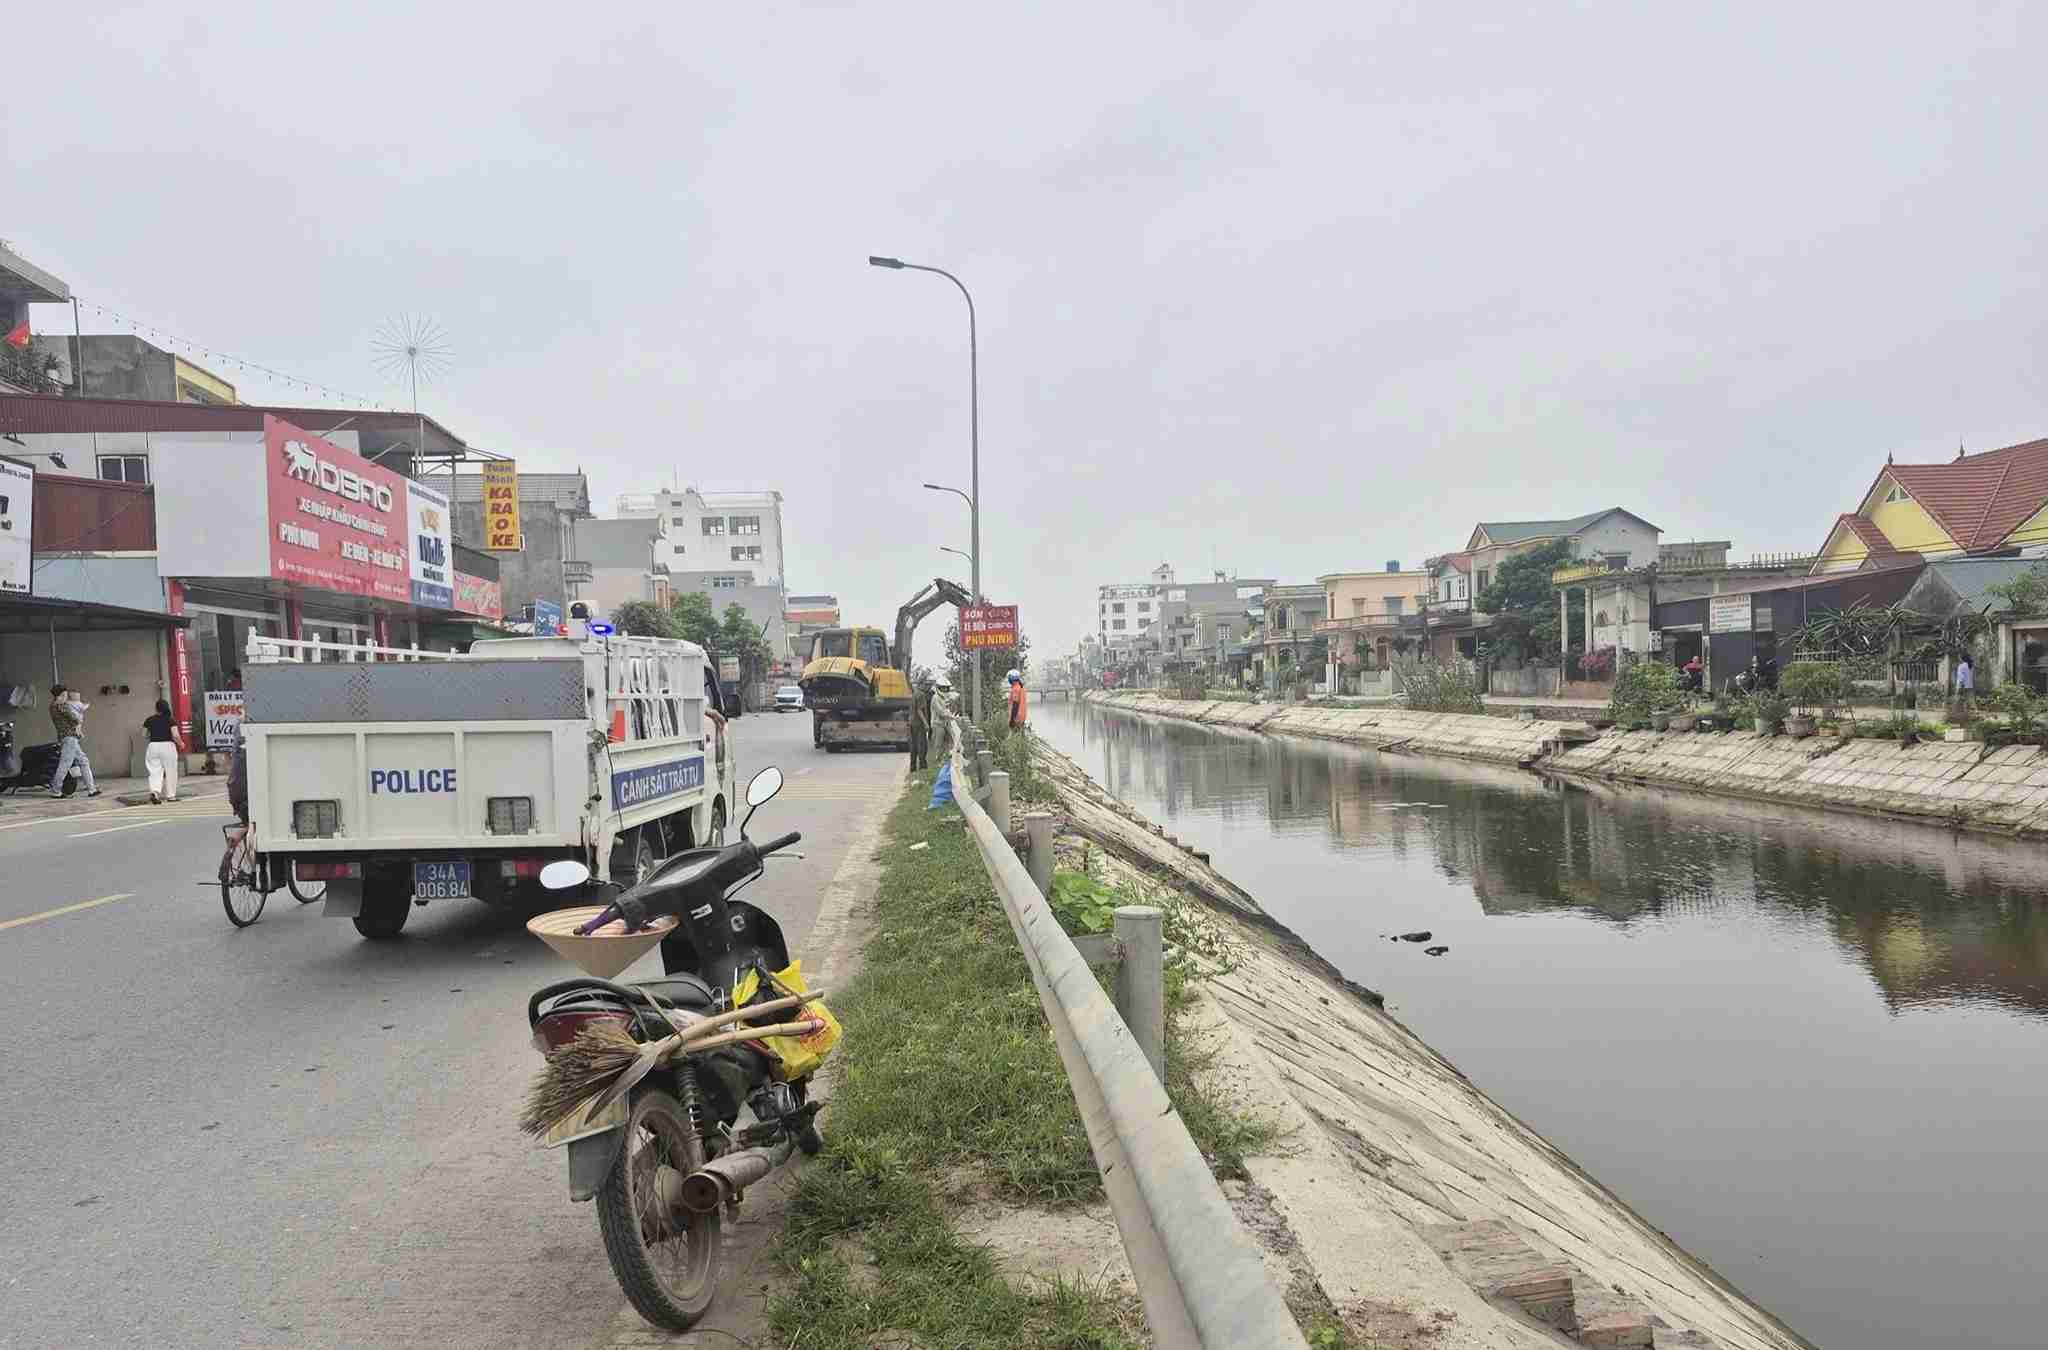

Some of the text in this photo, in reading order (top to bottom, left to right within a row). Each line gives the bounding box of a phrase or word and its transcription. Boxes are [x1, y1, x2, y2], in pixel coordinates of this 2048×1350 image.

[489, 487, 513, 499] KA
[491, 502, 513, 514] RA
[496, 518, 509, 530] O
[492, 534, 513, 546] KE
[371, 768, 457, 794] POLICE
[427, 863, 457, 881] 34A
